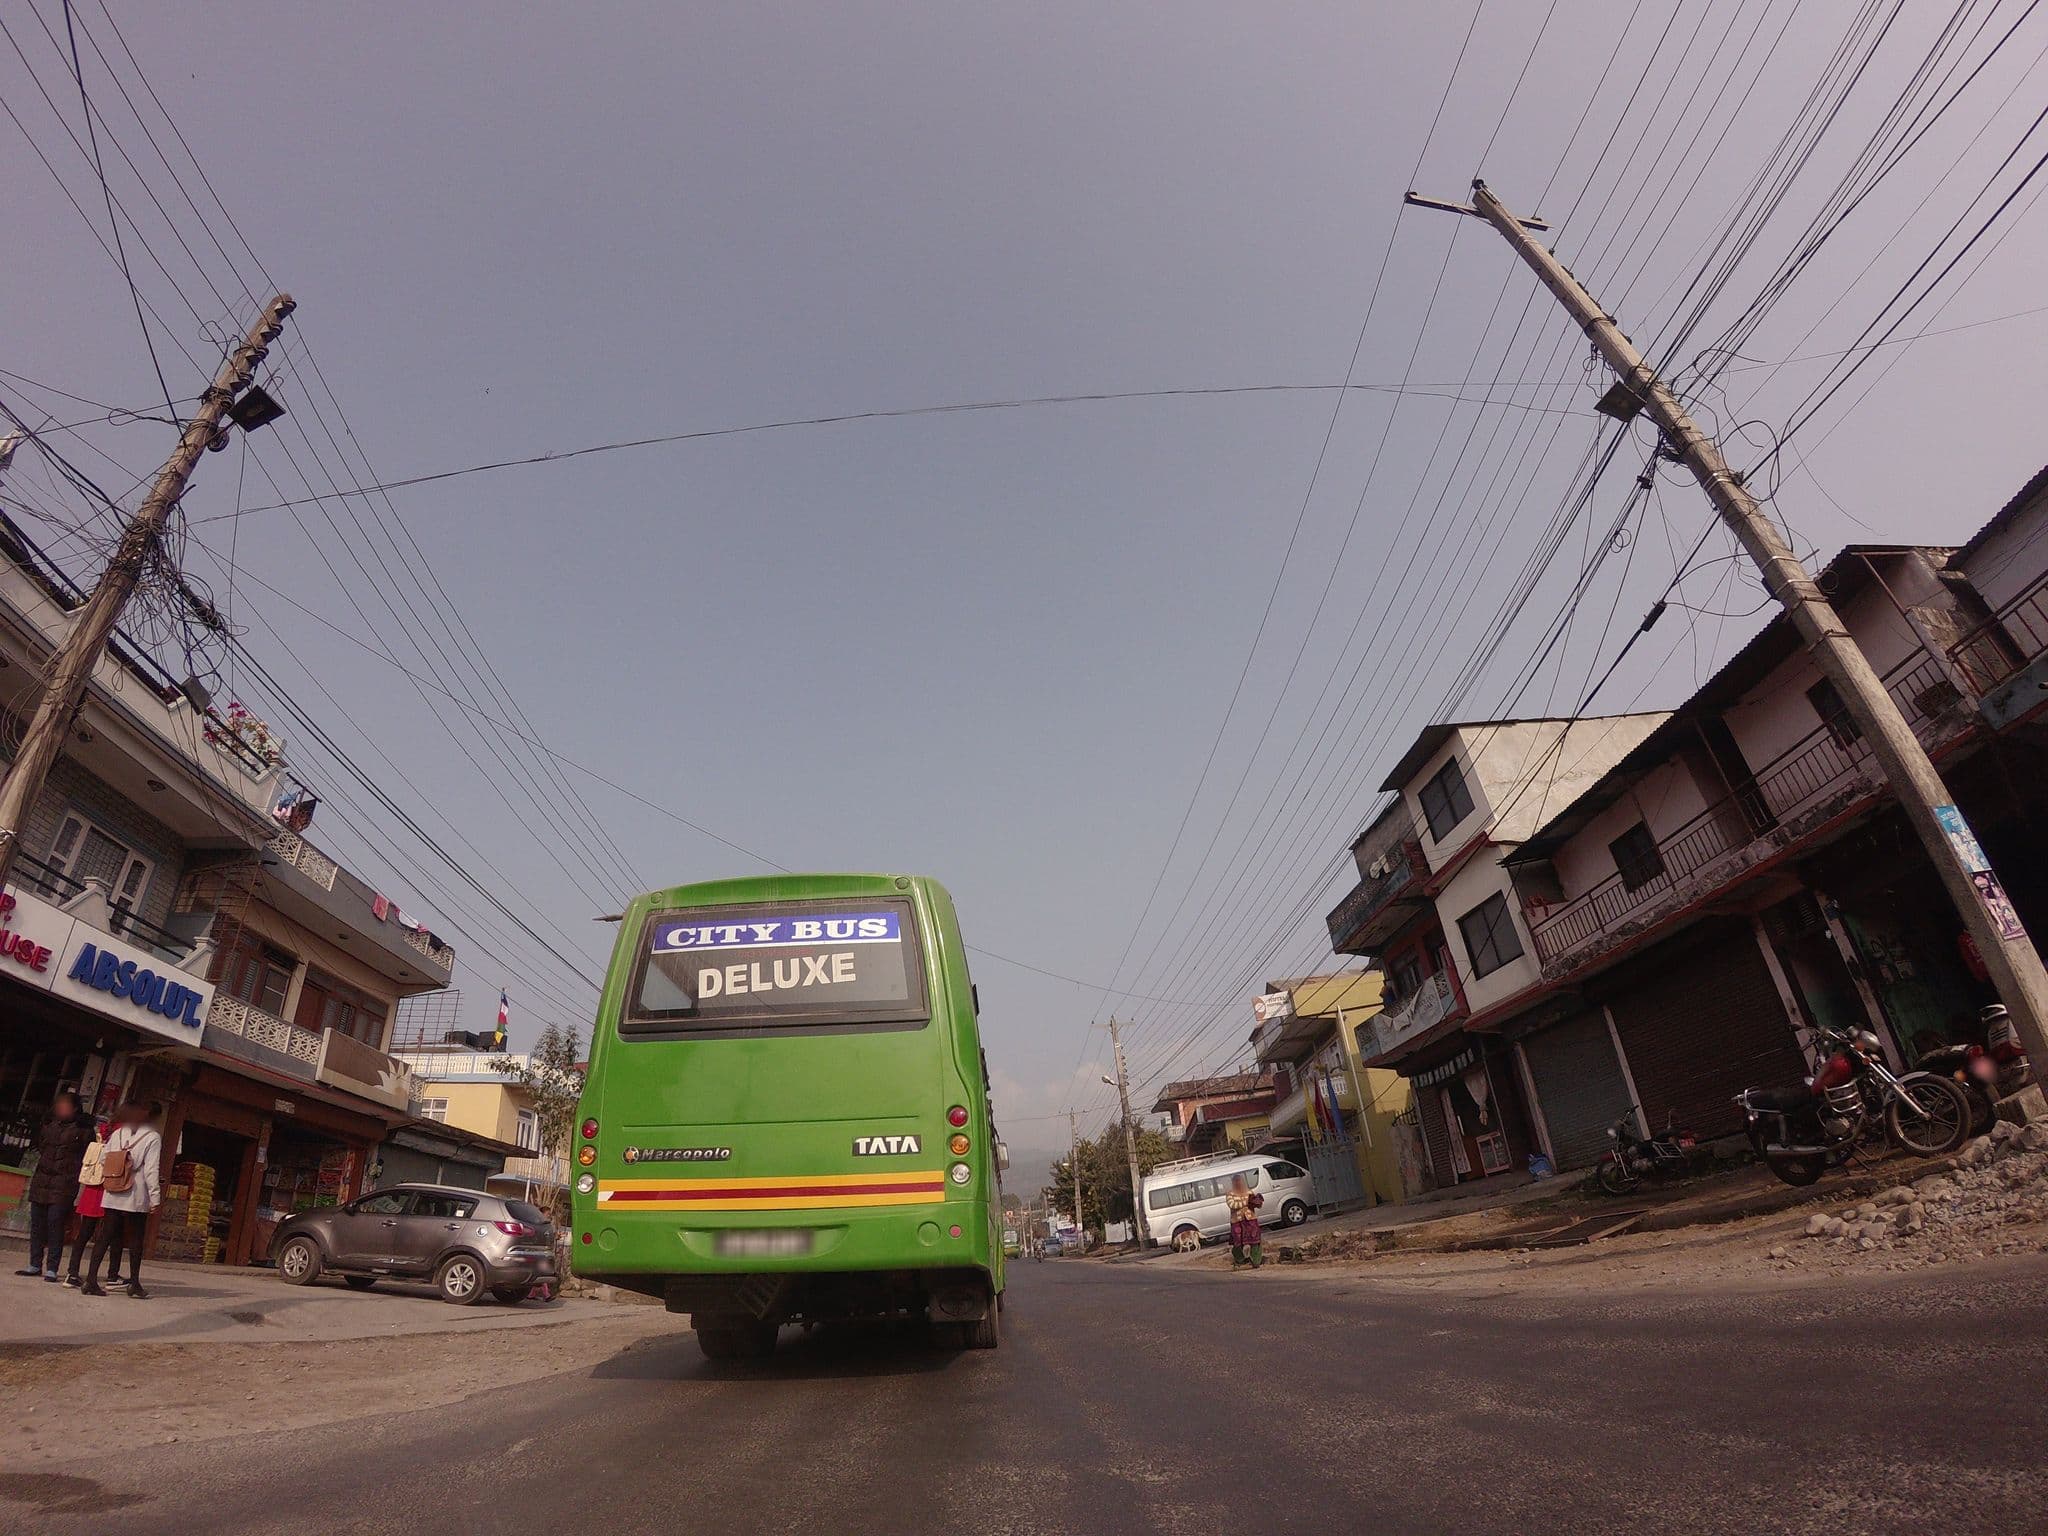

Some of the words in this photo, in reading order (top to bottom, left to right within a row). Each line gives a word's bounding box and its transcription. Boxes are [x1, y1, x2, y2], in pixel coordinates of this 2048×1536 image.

[667, 923, 780, 946] CITY
[791, 918, 888, 940] BUS
[698, 952, 857, 999] DELUXE
[641, 1147, 730, 1160] Marcopolo
[855, 1136, 919, 1155] TATA
